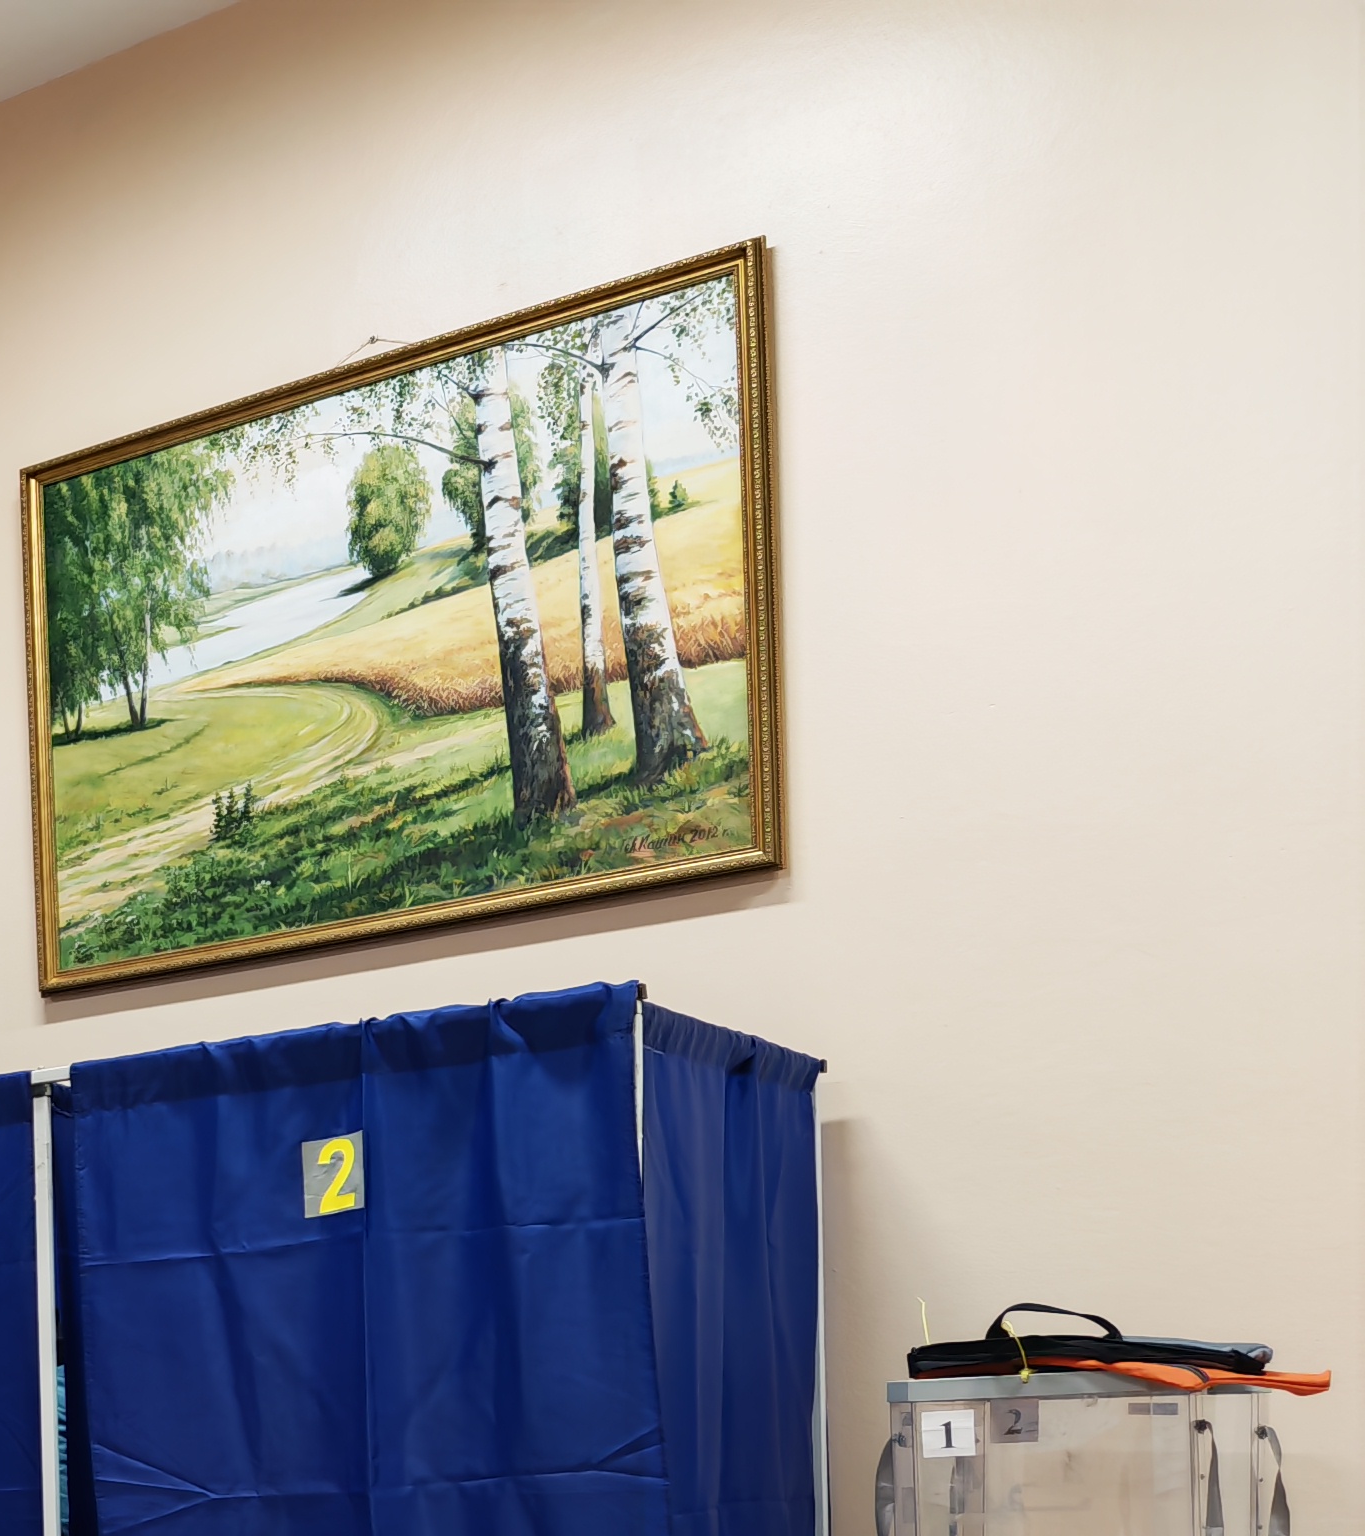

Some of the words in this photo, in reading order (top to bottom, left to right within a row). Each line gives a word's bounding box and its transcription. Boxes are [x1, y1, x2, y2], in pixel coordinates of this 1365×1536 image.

[317, 1138, 356, 1214] 2
[940, 1420, 957, 1449] 1
[1003, 1408, 1023, 1435] 2
